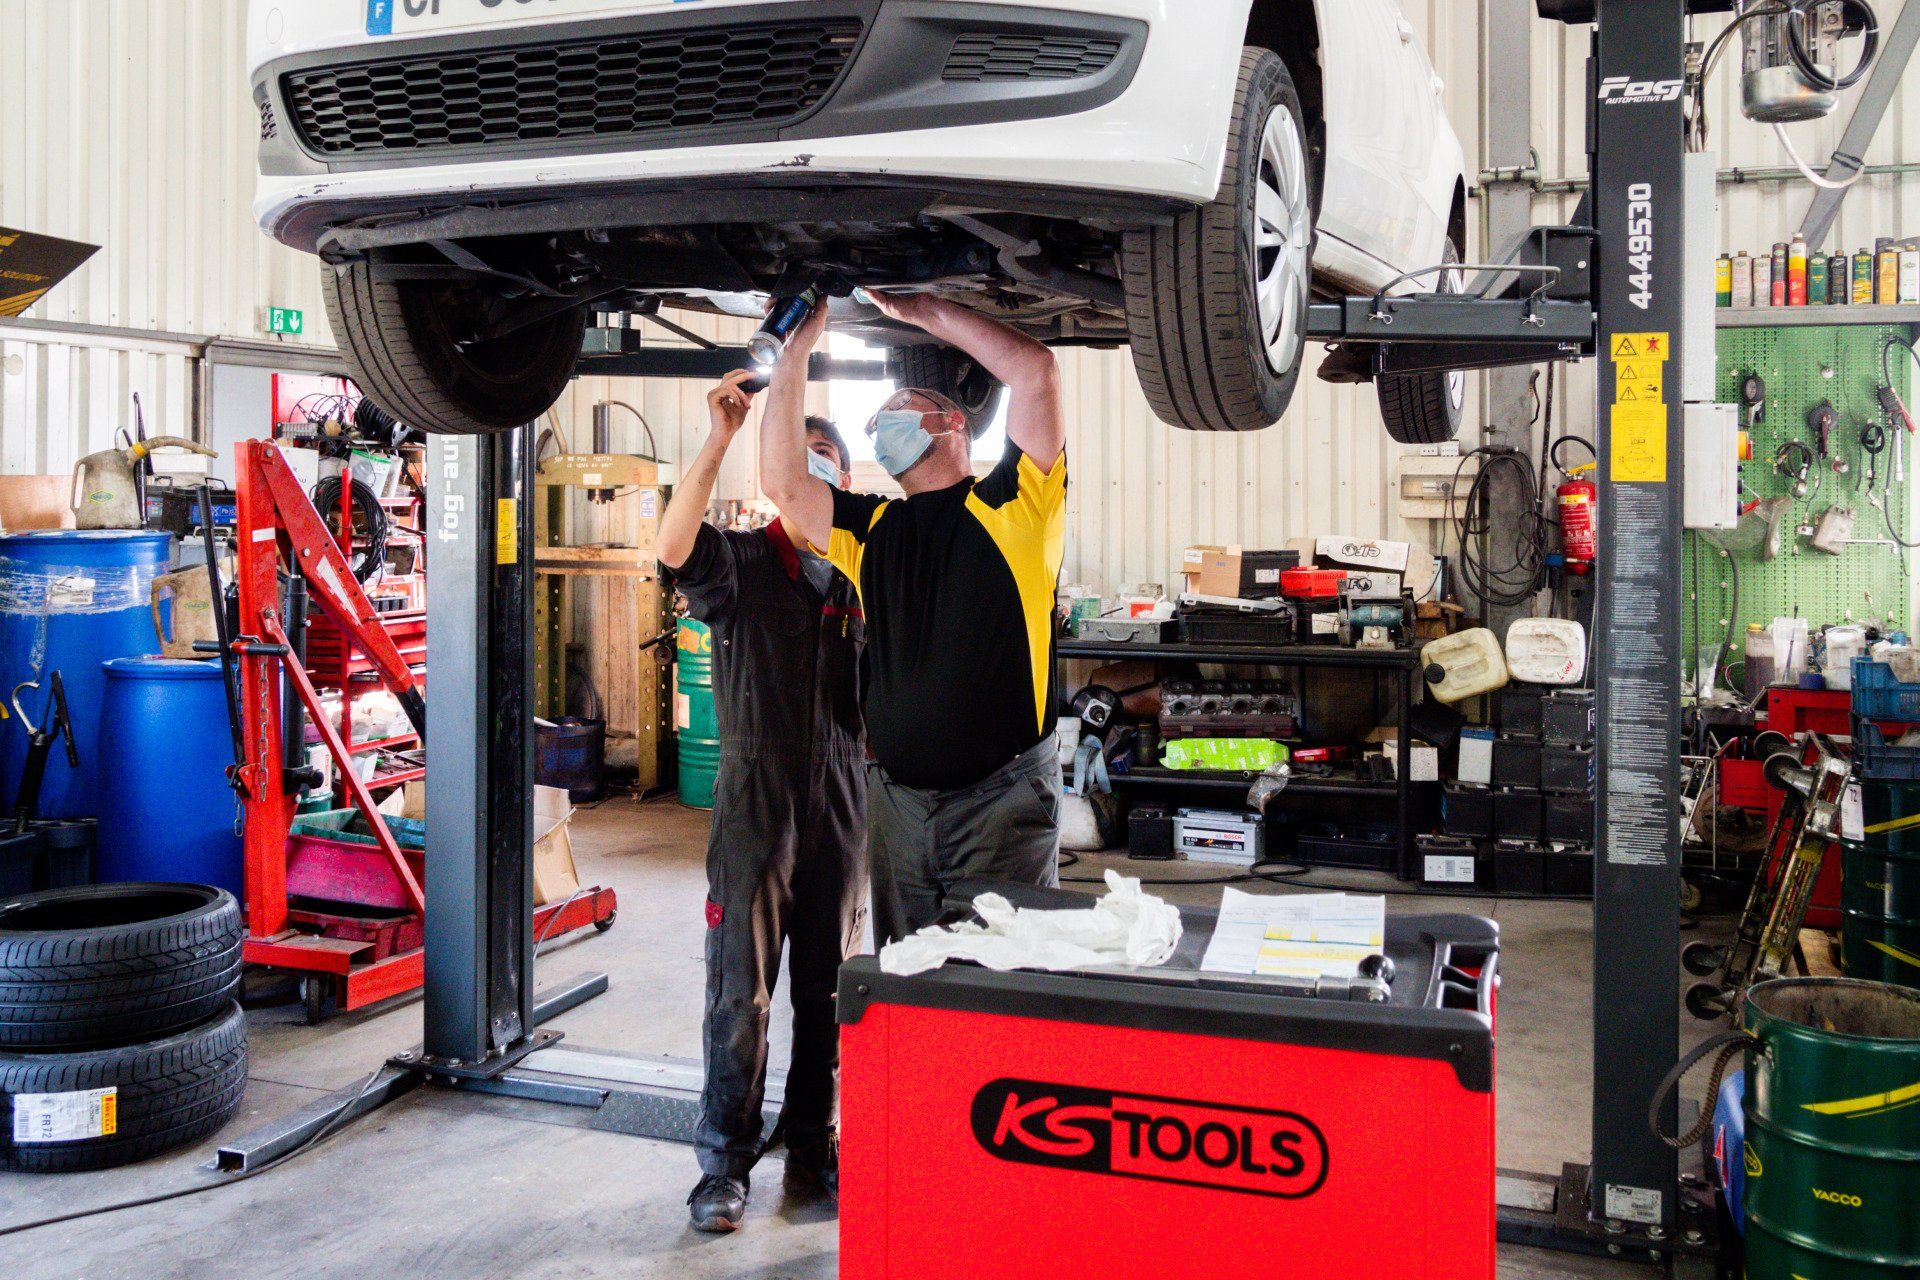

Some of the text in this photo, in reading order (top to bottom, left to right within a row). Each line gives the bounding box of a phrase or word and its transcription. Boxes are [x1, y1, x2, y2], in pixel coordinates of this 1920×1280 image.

[374, 1, 384, 19] F
[1597, 76, 1684, 101] Fog
[1604, 95, 1662, 105] AUTOMOTIVE
[1627, 183, 1652, 310] 4449530
[1223, 833, 1242, 841] BOSCH
[993, 1091, 1306, 1178] KS TOOLS
